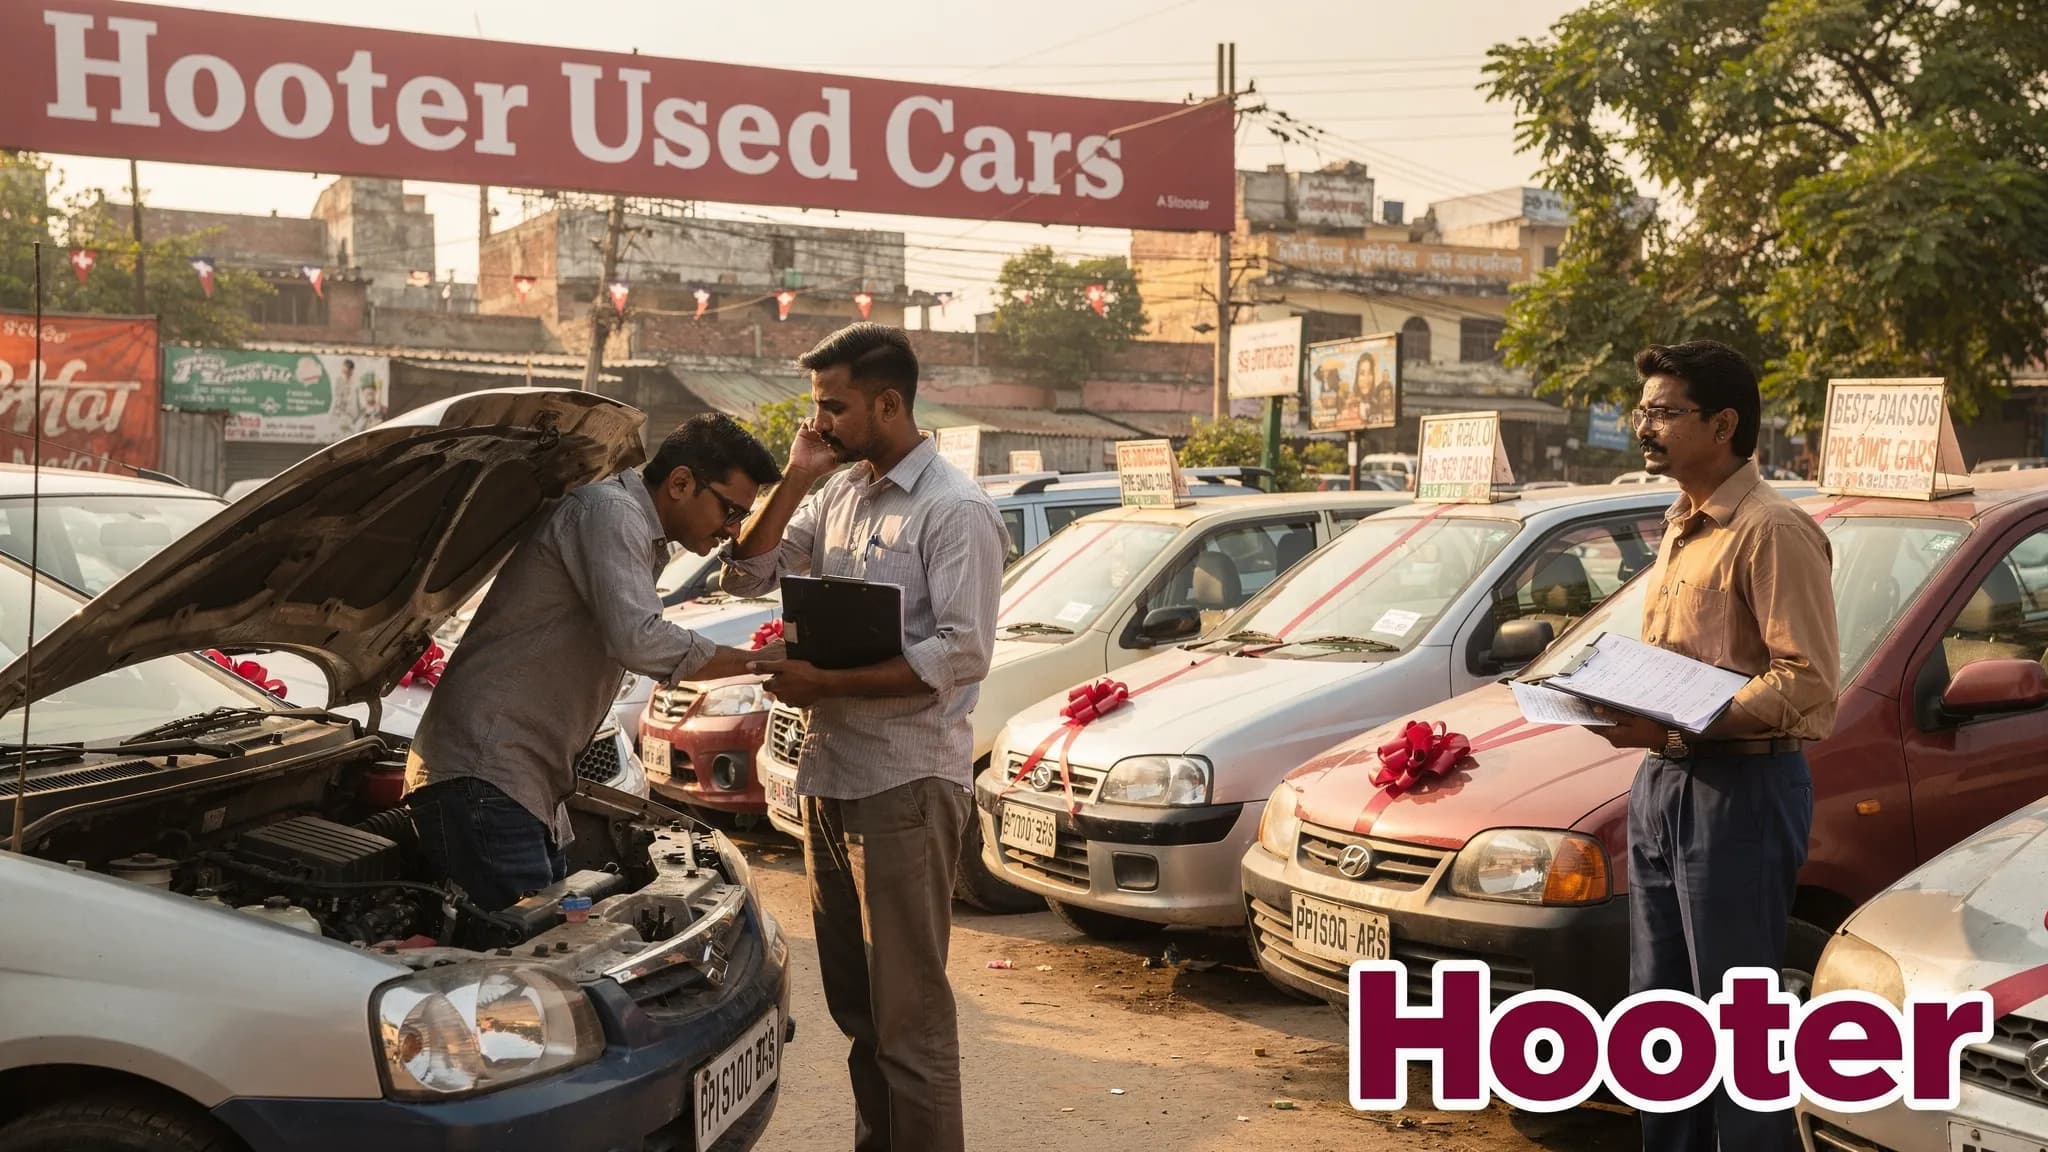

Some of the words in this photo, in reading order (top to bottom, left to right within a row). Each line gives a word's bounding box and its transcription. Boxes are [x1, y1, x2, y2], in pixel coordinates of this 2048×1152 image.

[44, 11, 528, 157] Hooter
[561, 62, 858, 182] Used
[885, 96, 1124, 200] Cars
